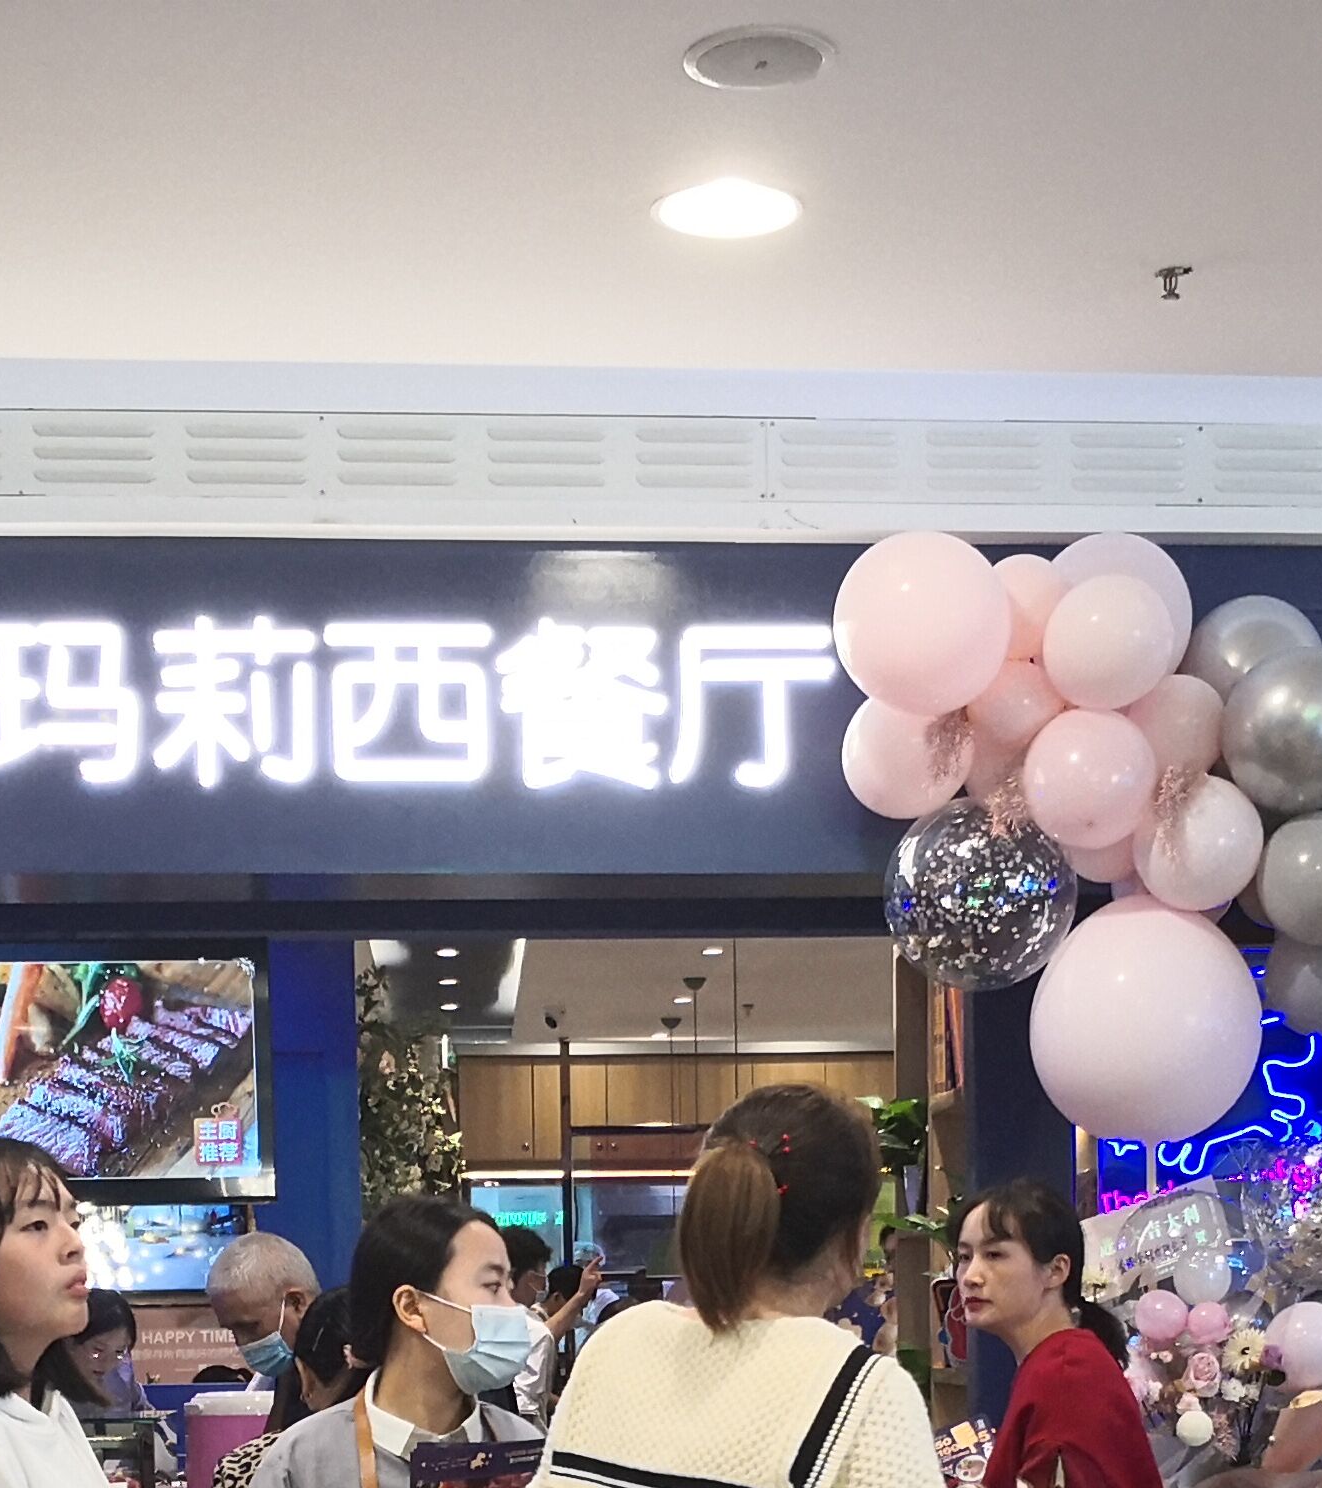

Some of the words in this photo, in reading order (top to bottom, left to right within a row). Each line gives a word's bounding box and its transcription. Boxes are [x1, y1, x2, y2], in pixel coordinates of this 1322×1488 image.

[198, 1119, 238, 1141] 主厨
[199, 1142, 239, 1163] 推荐
[141, 1330, 196, 1344] HAPPY
